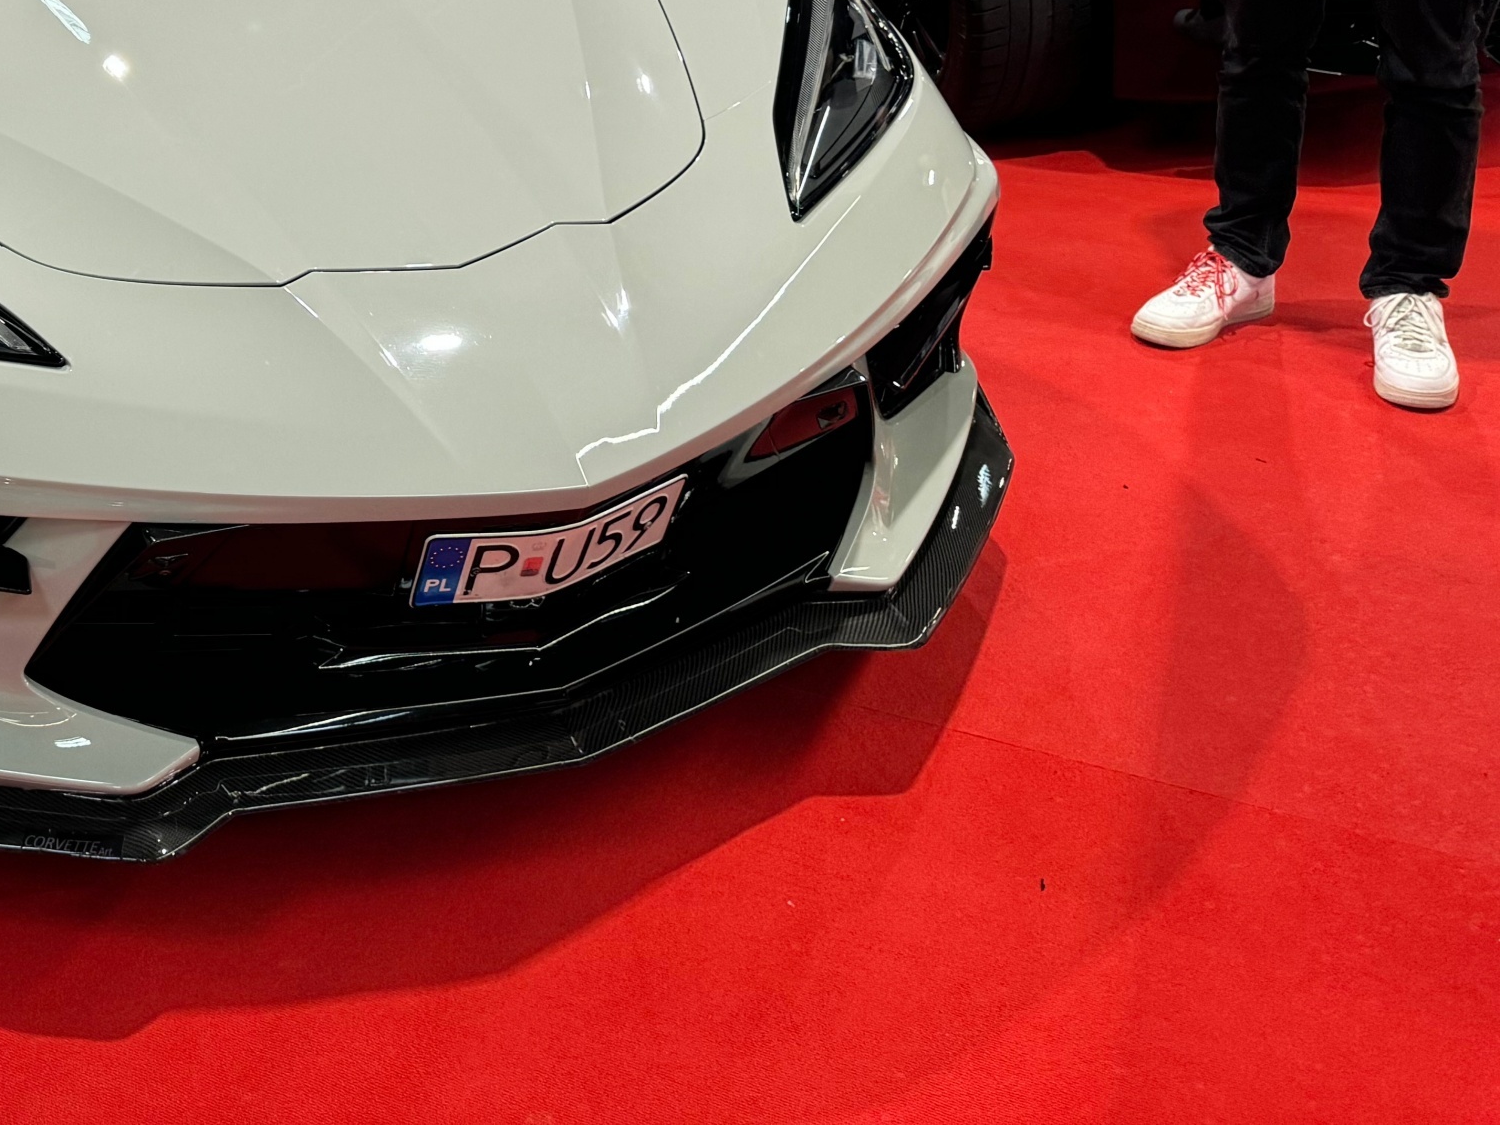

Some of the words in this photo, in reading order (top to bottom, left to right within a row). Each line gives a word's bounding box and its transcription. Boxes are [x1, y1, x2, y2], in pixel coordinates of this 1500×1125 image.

[462, 543, 520, 596] P
[544, 494, 669, 585] U59
[423, 578, 452, 594] PL
[24, 834, 101, 854] CORVETTE
